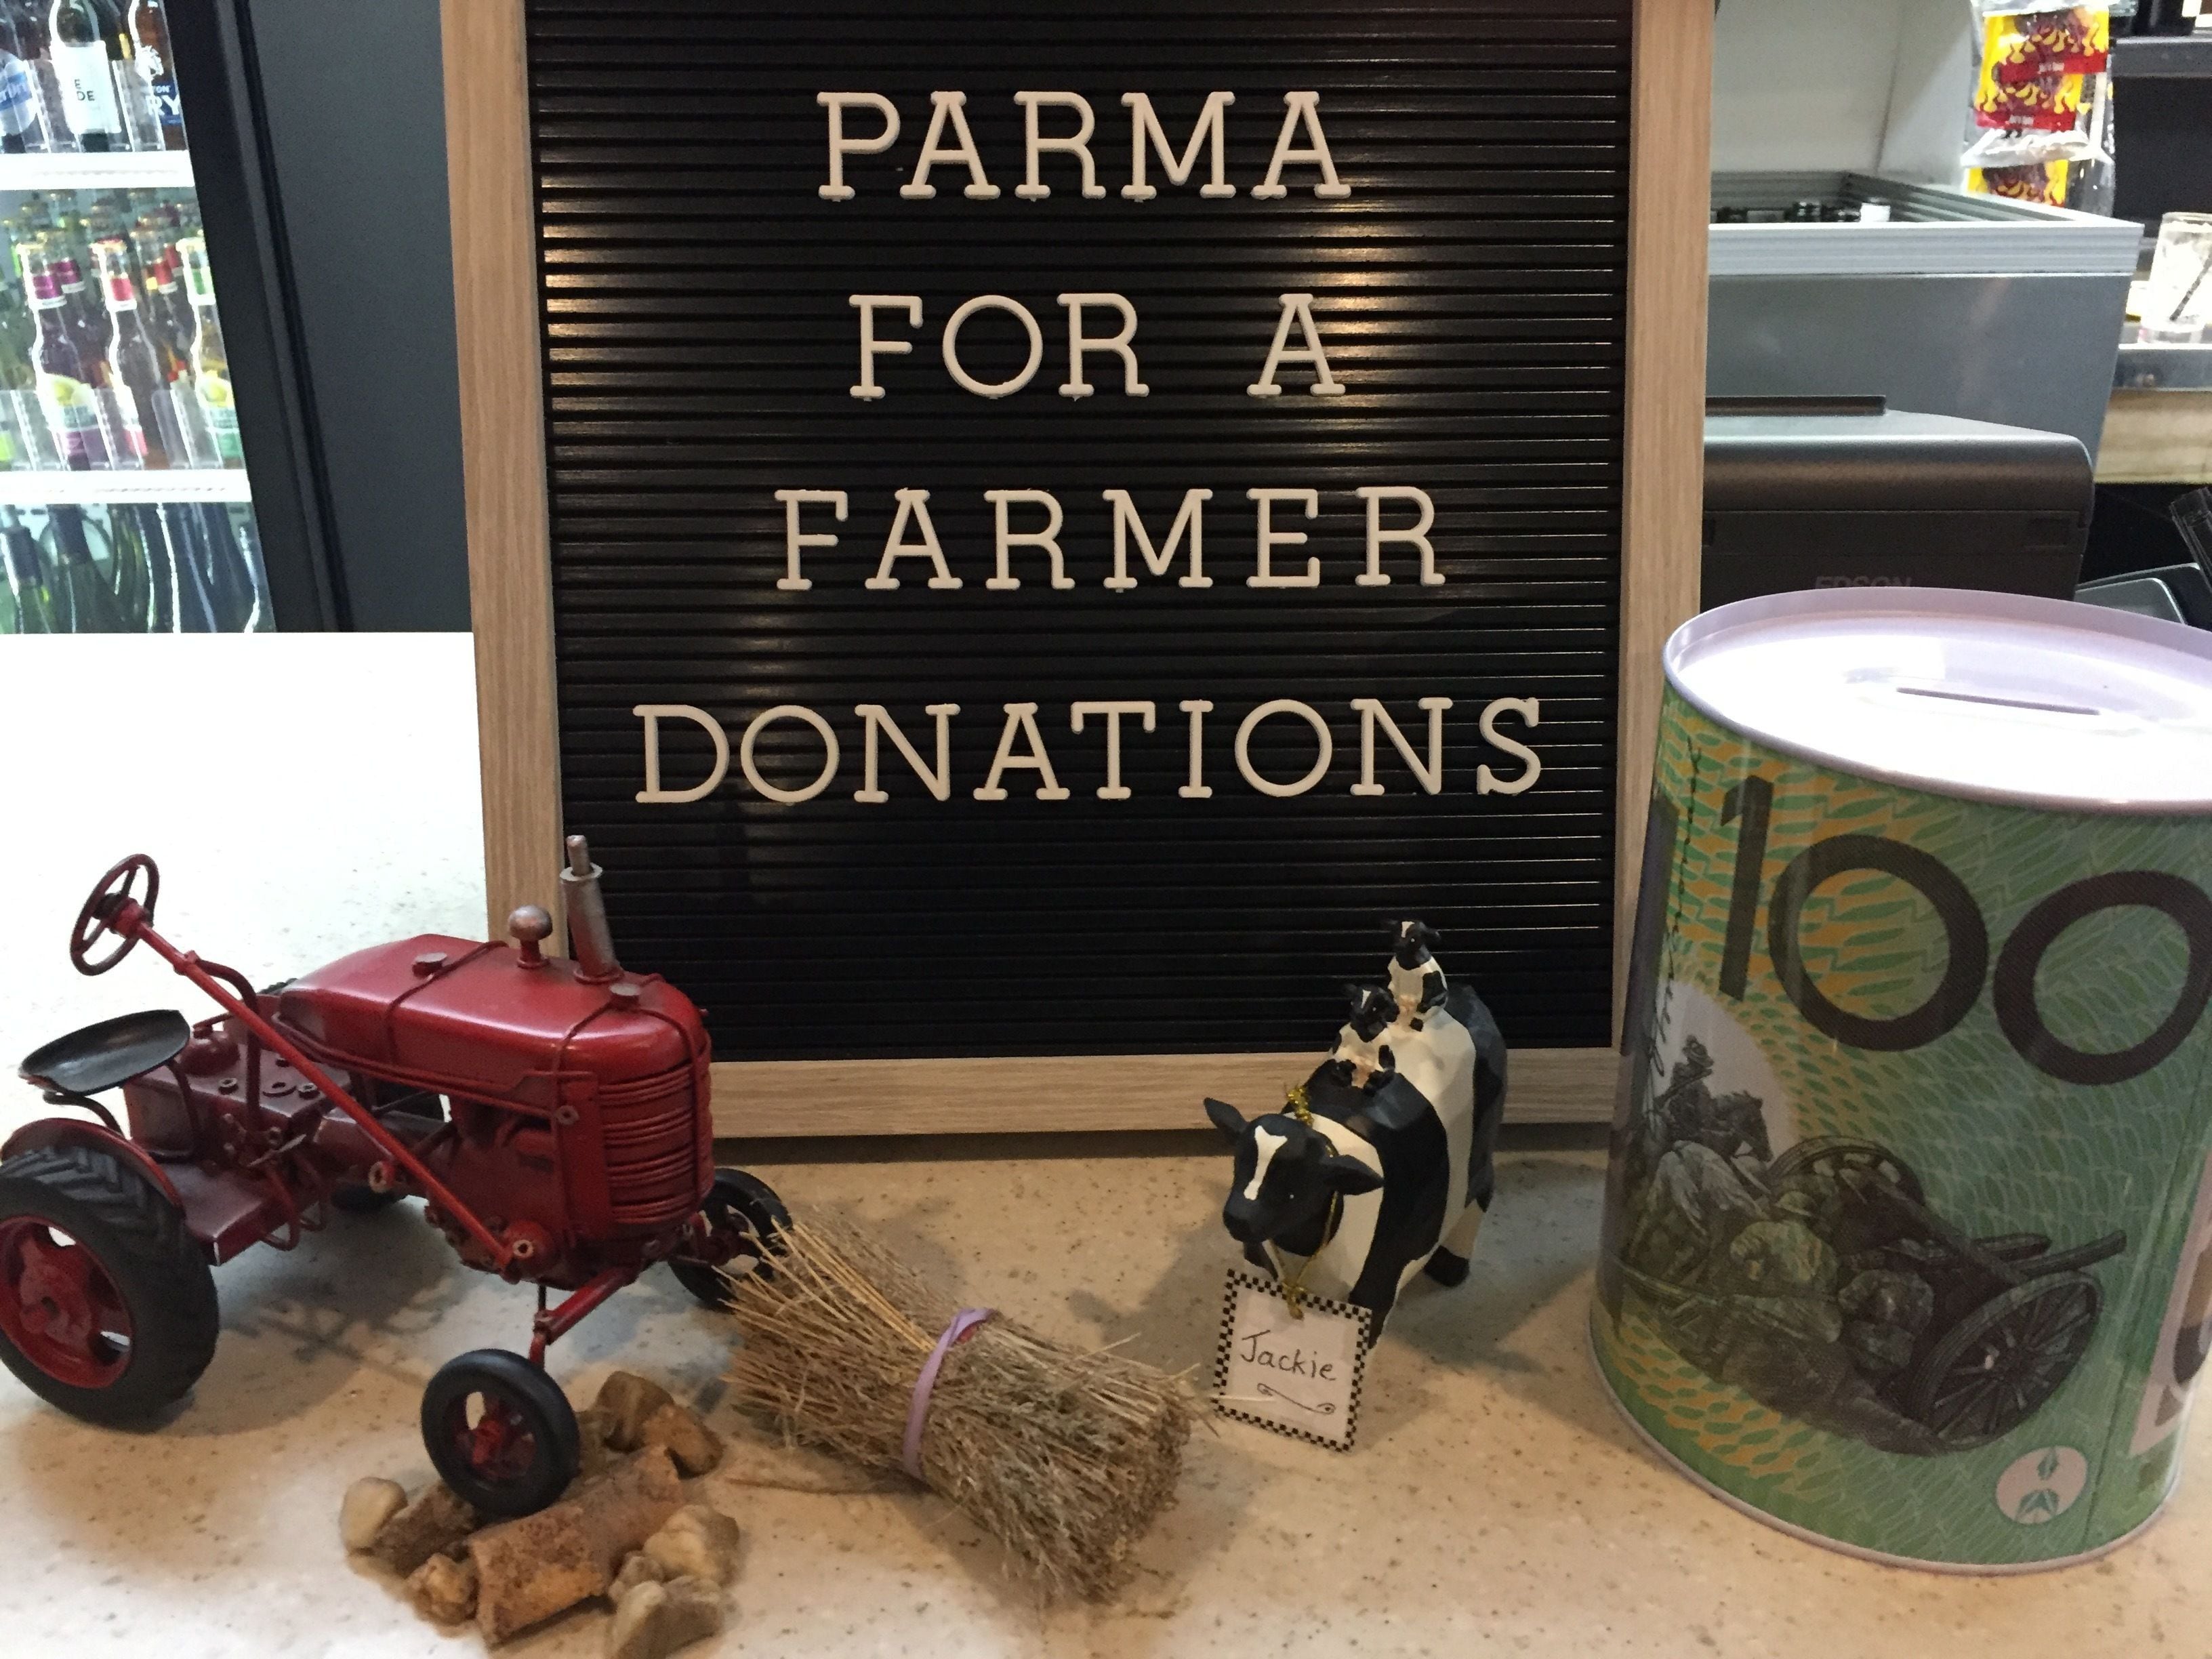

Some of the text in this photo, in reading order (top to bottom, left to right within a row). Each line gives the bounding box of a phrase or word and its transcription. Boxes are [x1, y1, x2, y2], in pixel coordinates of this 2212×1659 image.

[817, 90, 1353, 202] PARMA
[848, 293, 1347, 401] FOR A
[775, 486, 1446, 592] FARMER
[632, 695, 1547, 806] DONATIONS
[1719, 774, 2212, 1086] 100
[1240, 1329, 1336, 1381] Jackie
